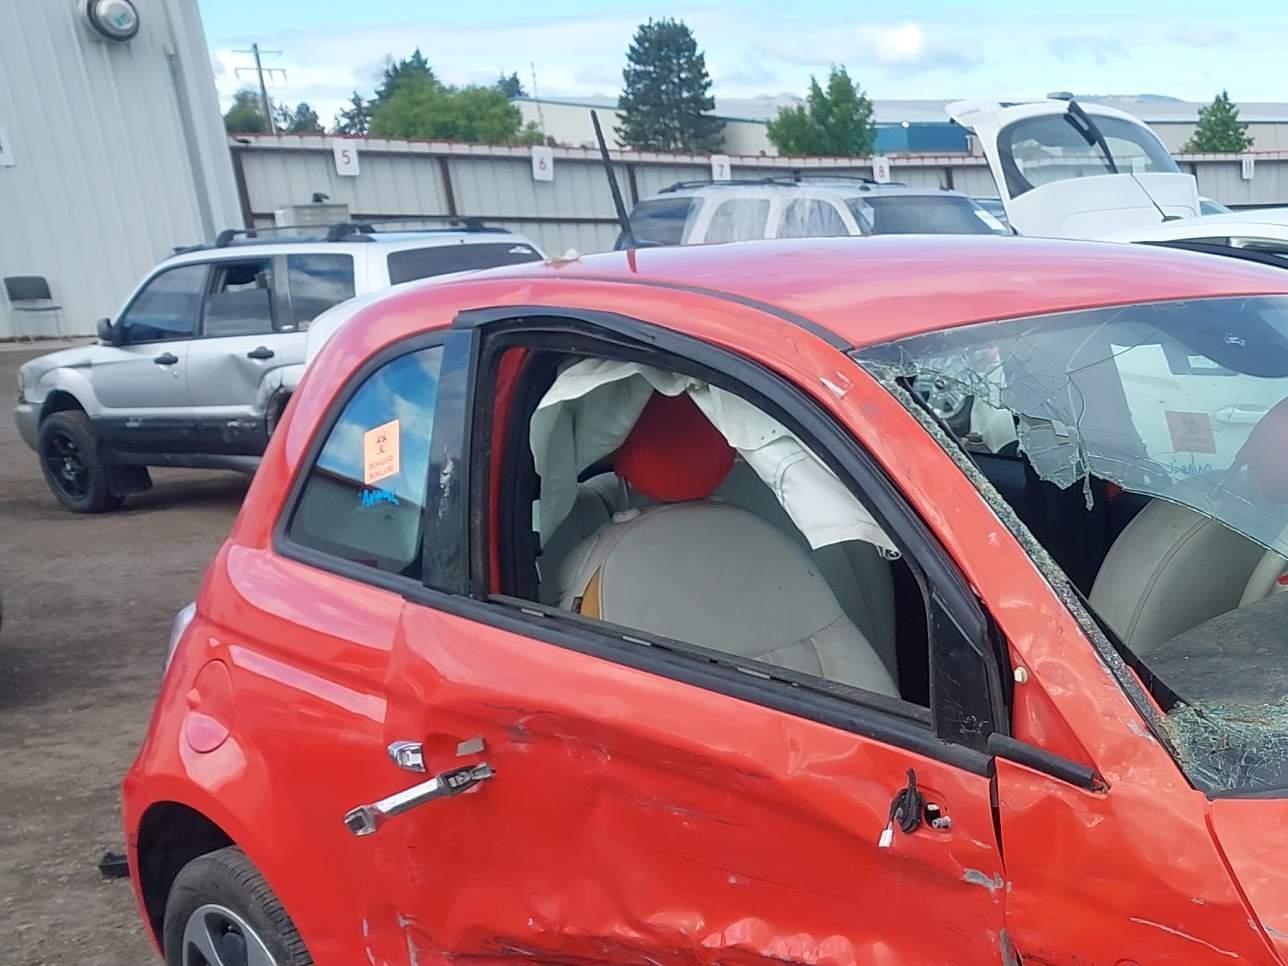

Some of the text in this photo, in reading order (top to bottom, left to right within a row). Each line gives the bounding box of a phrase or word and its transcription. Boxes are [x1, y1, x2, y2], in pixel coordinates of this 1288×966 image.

[342, 150, 351, 165] 5
[539, 156, 546, 170] 6
[717, 163, 725, 177] 7
